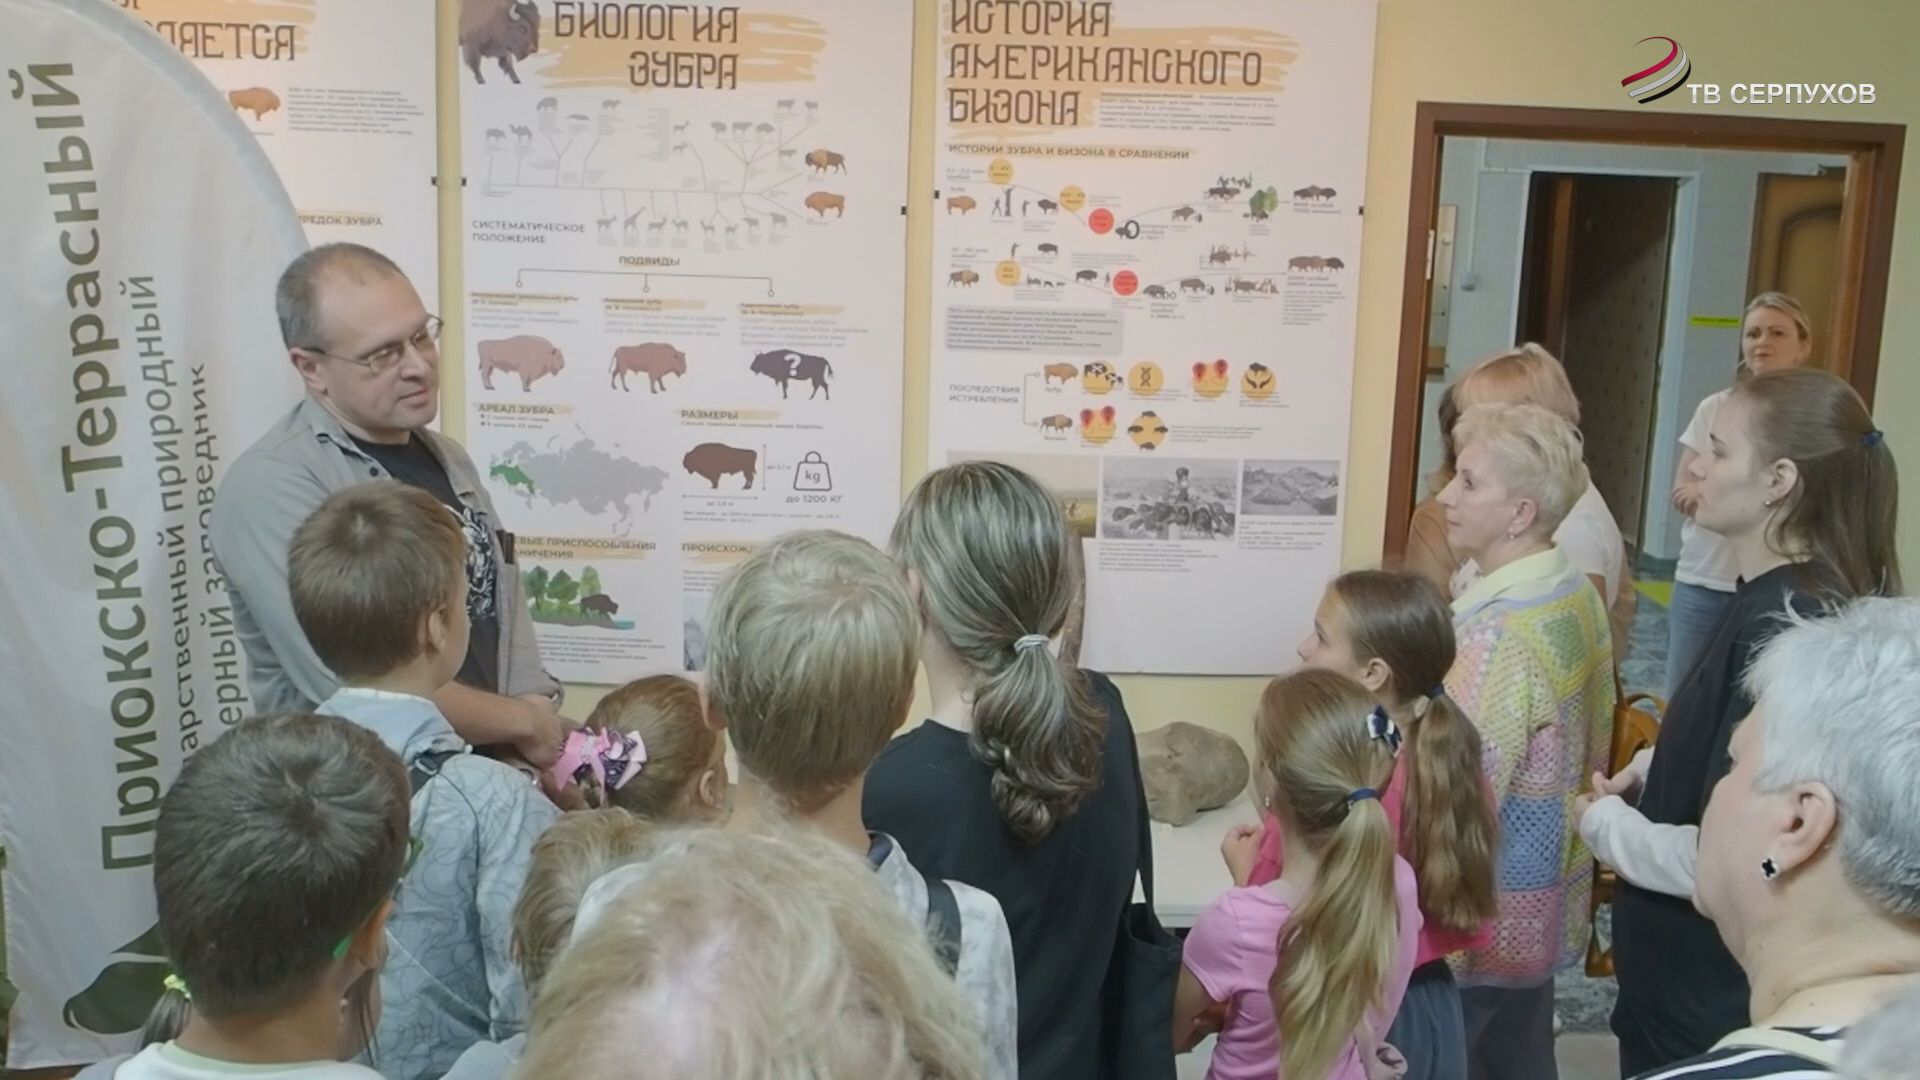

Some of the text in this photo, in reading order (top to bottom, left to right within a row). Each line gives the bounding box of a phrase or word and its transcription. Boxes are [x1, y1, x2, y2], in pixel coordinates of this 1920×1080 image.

[553, 2, 740, 43] БИОЛОГИЯ
[950, 0, 1110, 37] ИСТОРИЯ
[144, 20, 296, 61] ЛЯЕТСЯ
[628, 51, 739, 90] ЗУБРА
[947, 43, 1262, 87] АМЕРИКАНСКОГО
[948, 88, 1081, 127] БИЗОНА
[949, 144, 1190, 160] ИСТОРИИ ЗУБРА И БИЗОНА В СРАВНЕНИИ
[472, 220, 586, 233] СИСТЕМАТИЧЕСКОЕ
[472, 232, 547, 244] ПОЛОЖЕНИЕ
[681, 410, 739, 420] РАЗМЕРЫ
[8, 62, 160, 870] Приокско-Террасный
[805, 469, 821, 484] kg
[803, 494, 827, 504] 1200
[119, 275, 203, 766] арственный природный
[199, 605, 249, 726] ерный
